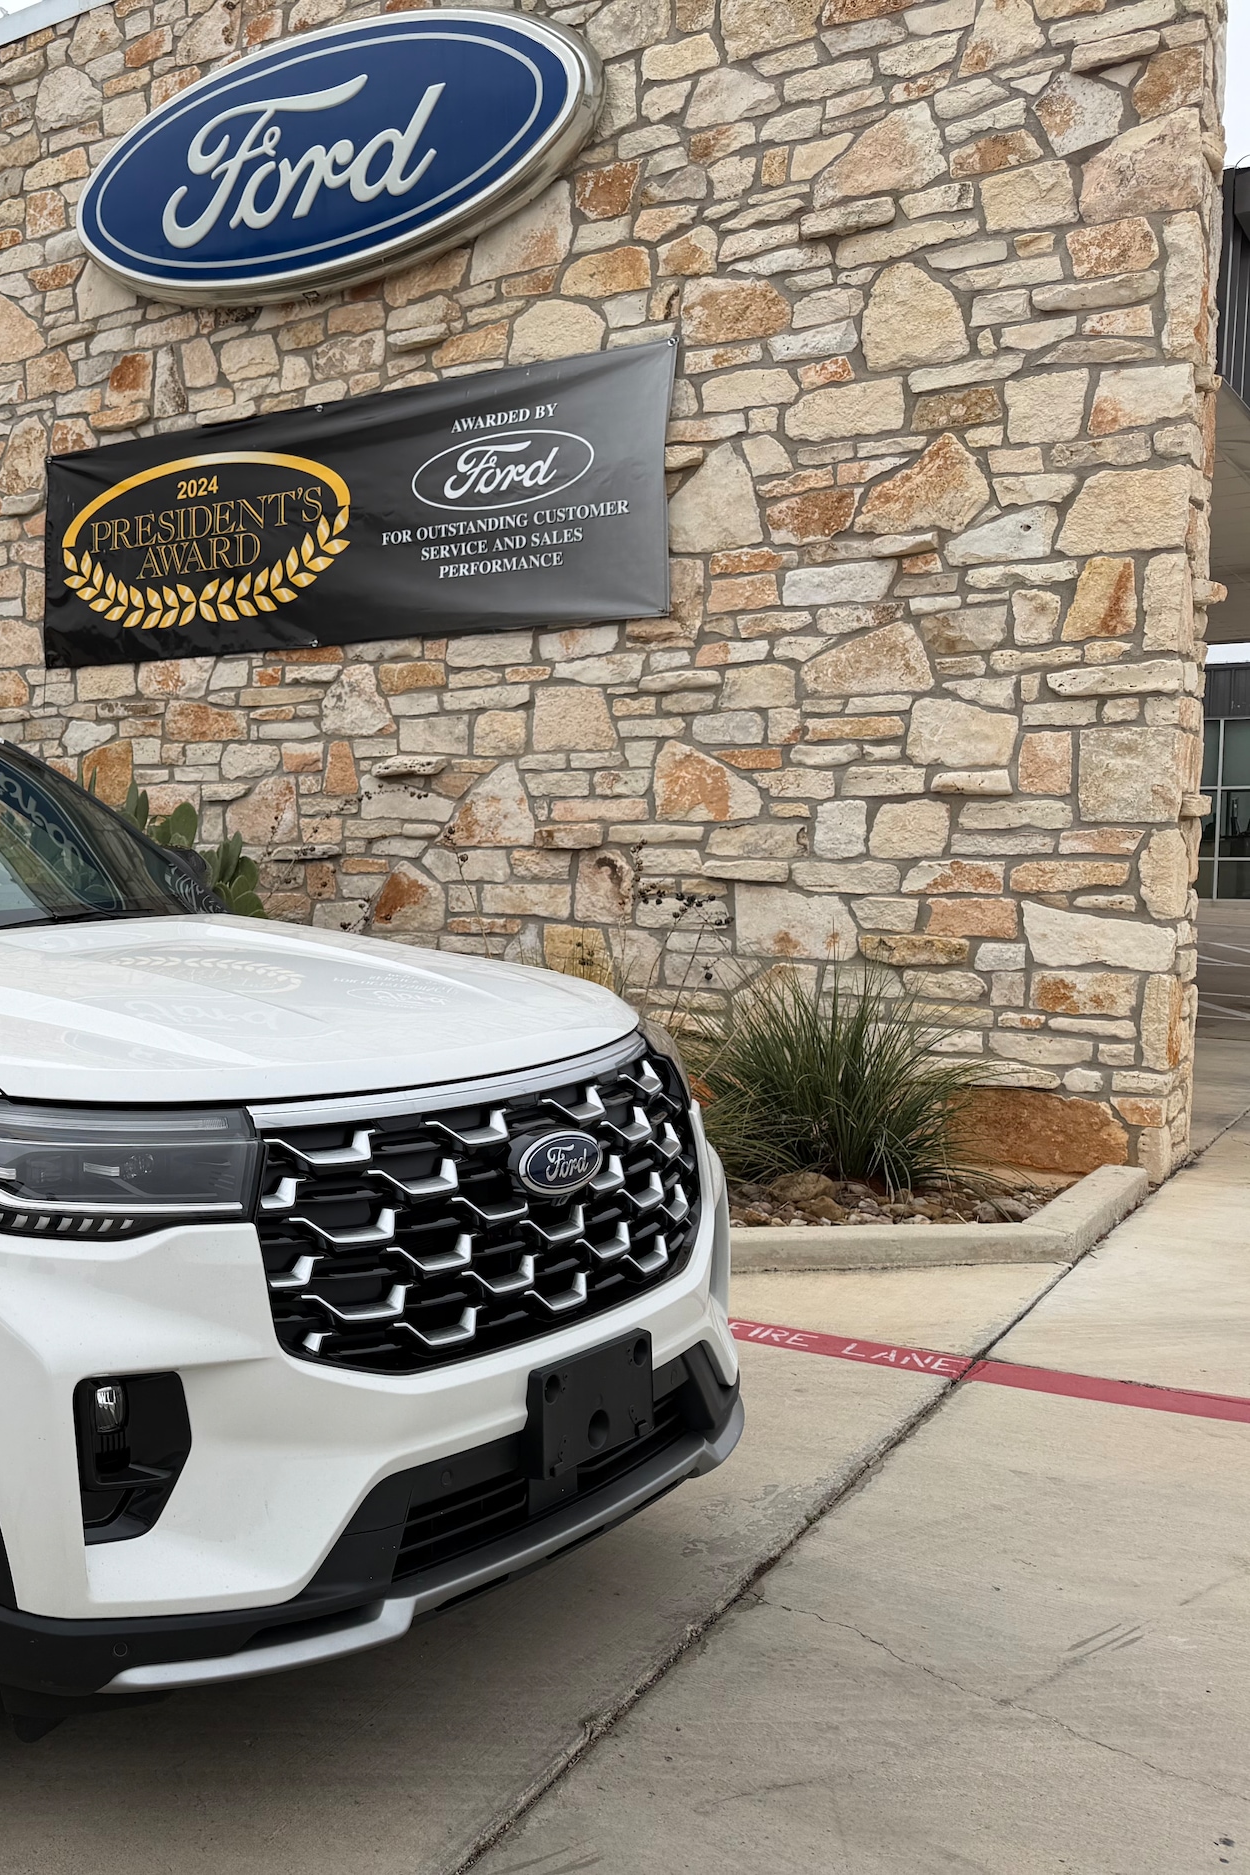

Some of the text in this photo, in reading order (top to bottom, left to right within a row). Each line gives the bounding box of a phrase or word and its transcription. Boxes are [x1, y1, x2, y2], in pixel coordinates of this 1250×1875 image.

[162, 74, 445, 248] Ford
[450, 402, 558, 433] AWARDED BY
[176, 475, 219, 500] 2024
[443, 440, 561, 499] Ford
[90, 487, 324, 554] PRESIDENT'S
[381, 499, 630, 546] FOR OUTSTANDING CUSTOMER
[421, 527, 584, 561] SERVICE AND SALES
[136, 532, 261, 580] AWARD
[438, 552, 564, 579] PERFORMANCE
[546, 1144, 589, 1182] Ford
[729, 1321, 965, 1373] FIRE LANE
